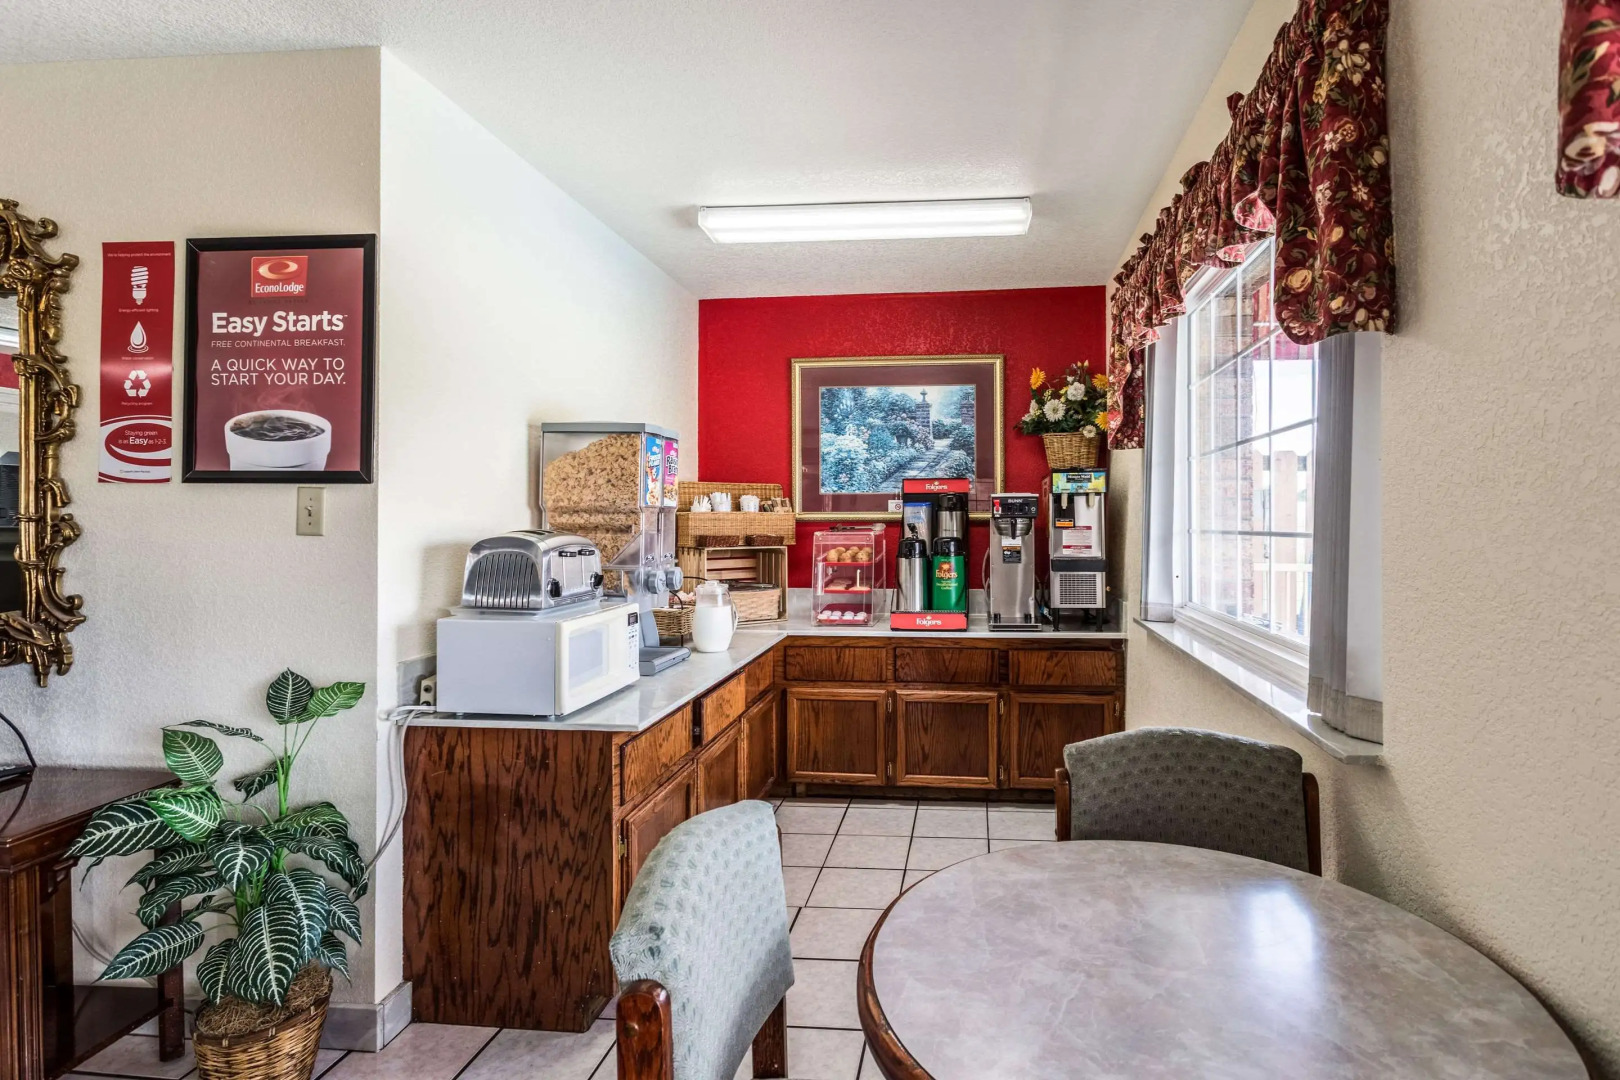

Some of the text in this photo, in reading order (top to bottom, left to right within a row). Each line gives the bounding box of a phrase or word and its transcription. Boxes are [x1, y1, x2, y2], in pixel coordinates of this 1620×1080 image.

[255, 282, 304, 294] EconoLodge
[212, 312, 268, 337] Easy
[211, 338, 346, 348] FREE CONTINENTAL BREAKFAST.
[211, 357, 345, 371] A QUICK WAY TO
[211, 372, 346, 386] START YOUR DAY.
[129, 437, 148, 447] Easy
[925, 483, 948, 491] Folgers
[935, 569, 958, 579] Folgers
[916, 617, 942, 626] Folgers
